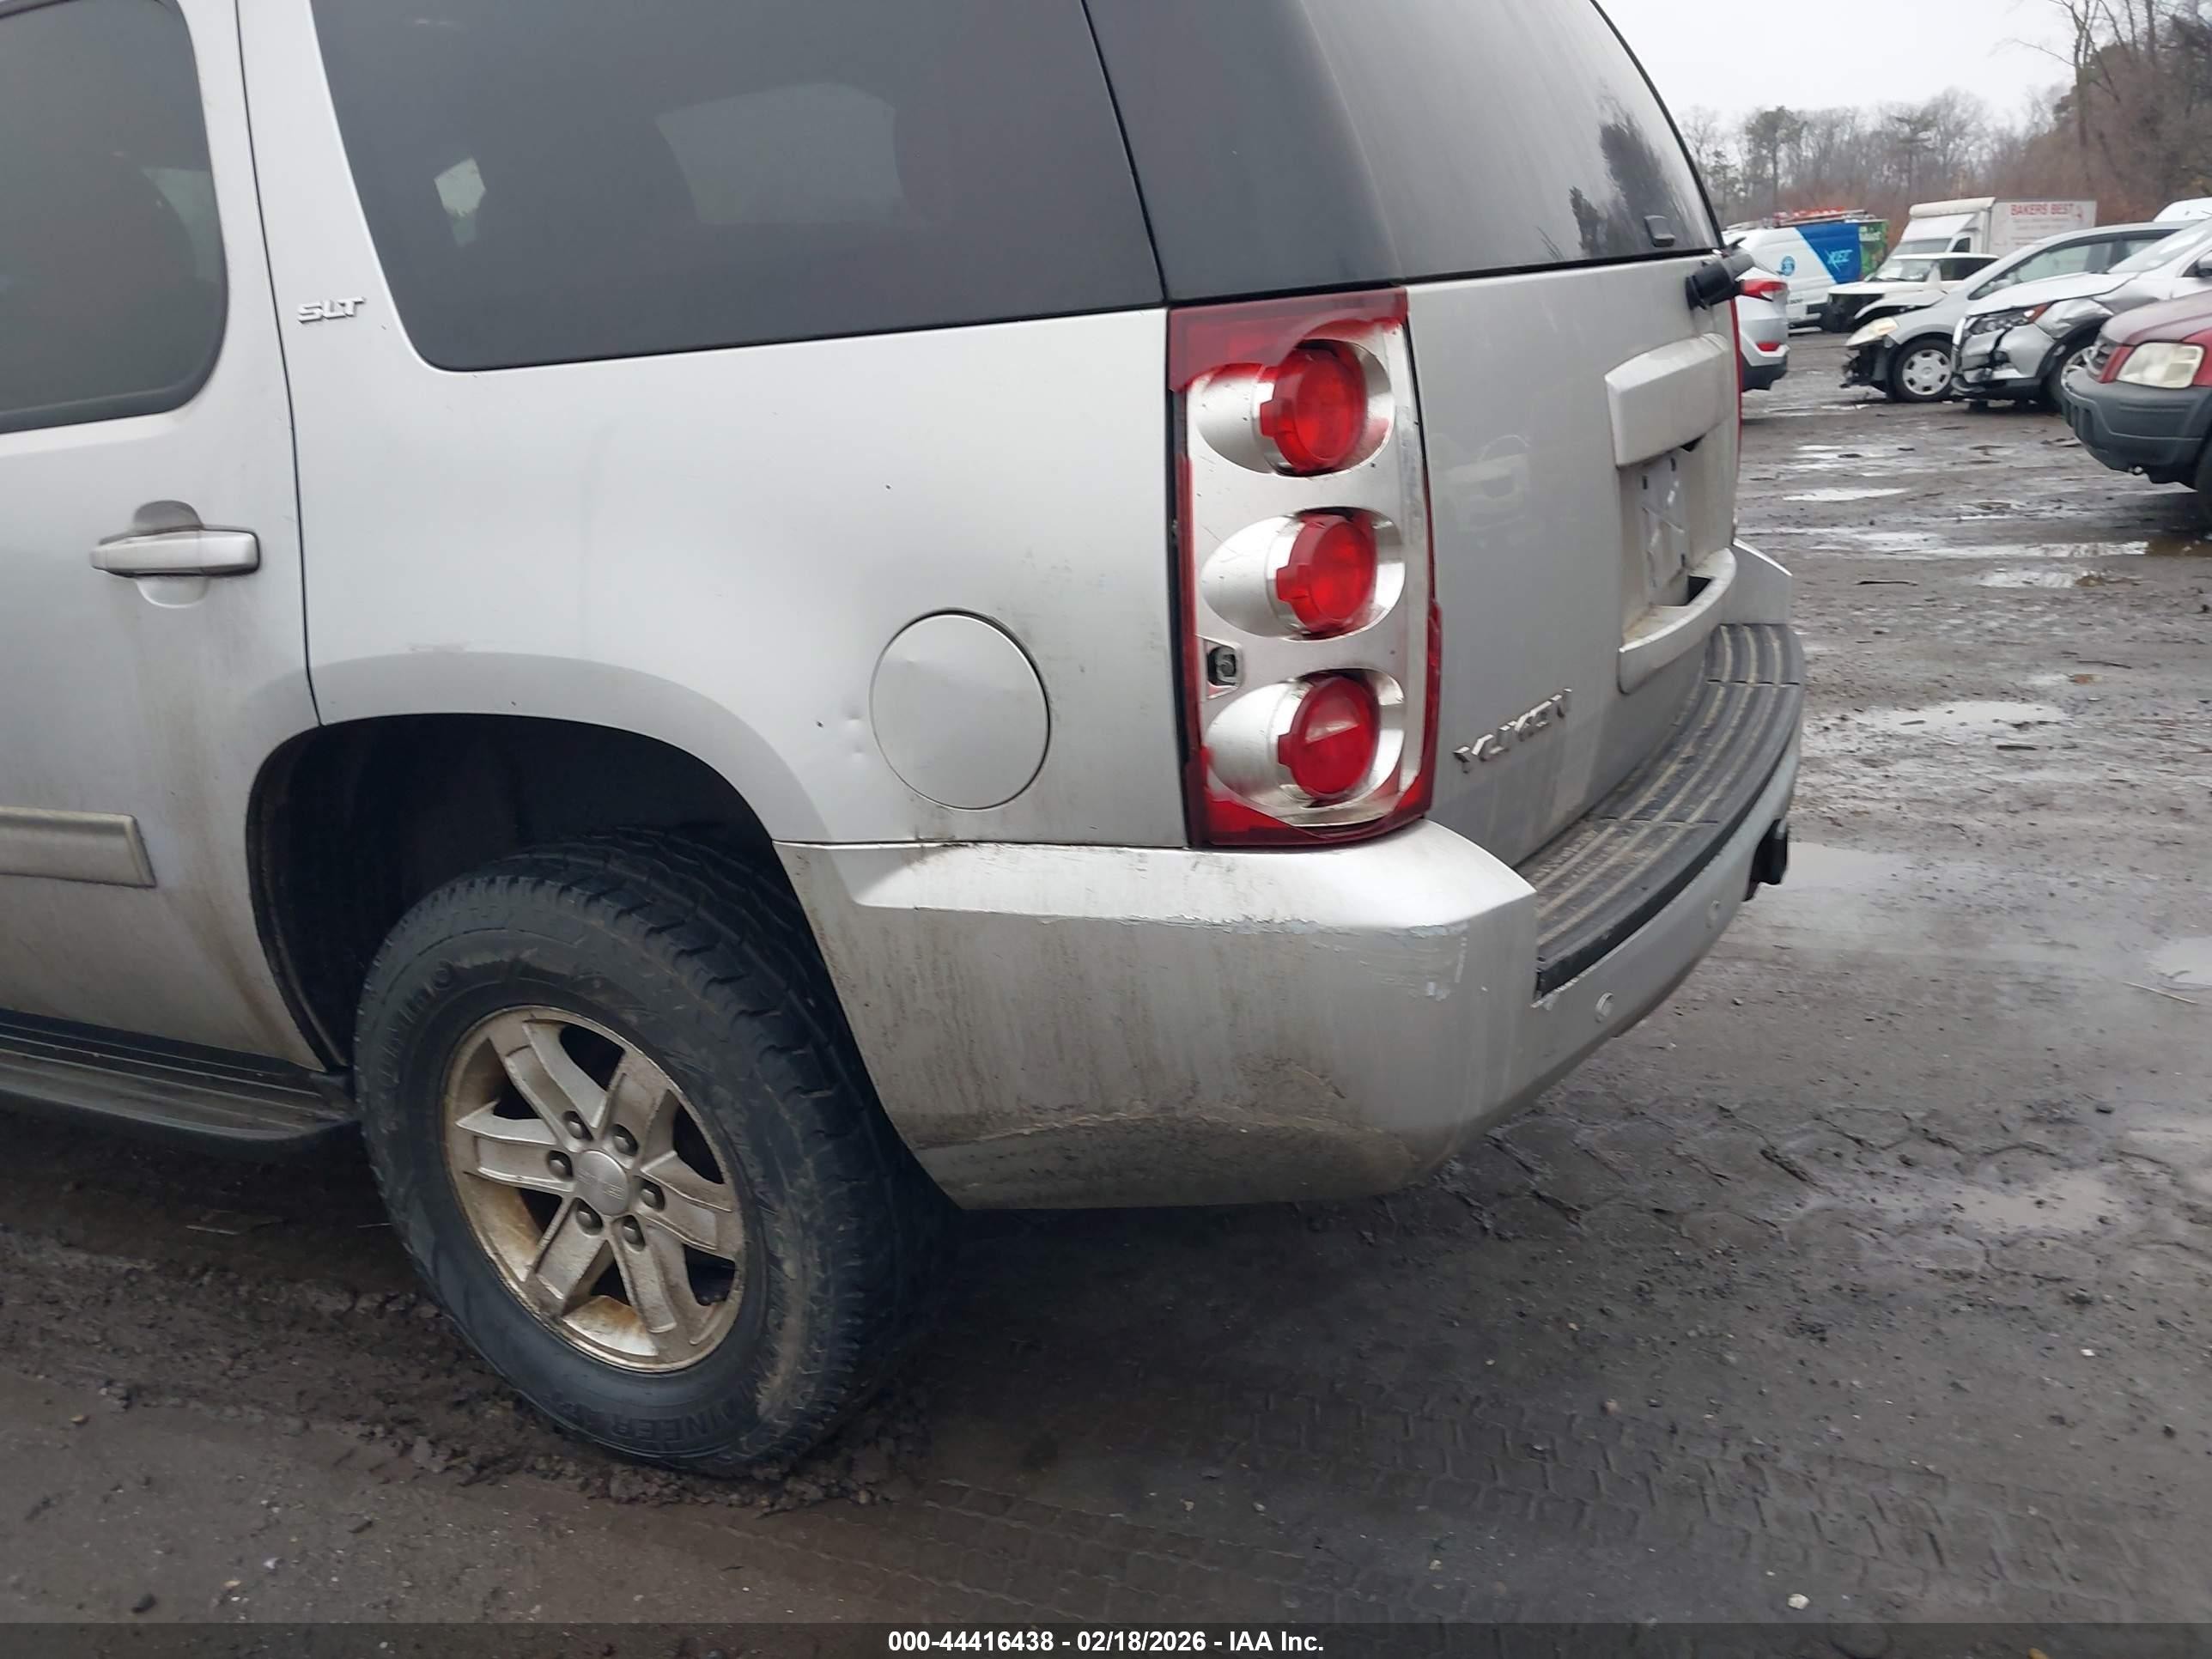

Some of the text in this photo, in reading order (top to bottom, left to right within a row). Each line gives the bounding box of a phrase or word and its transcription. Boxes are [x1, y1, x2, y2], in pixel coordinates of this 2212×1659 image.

[2051, 204, 2075, 215] BEST
[297, 295, 365, 324] SLT
[1453, 688, 1572, 773] YUKON
